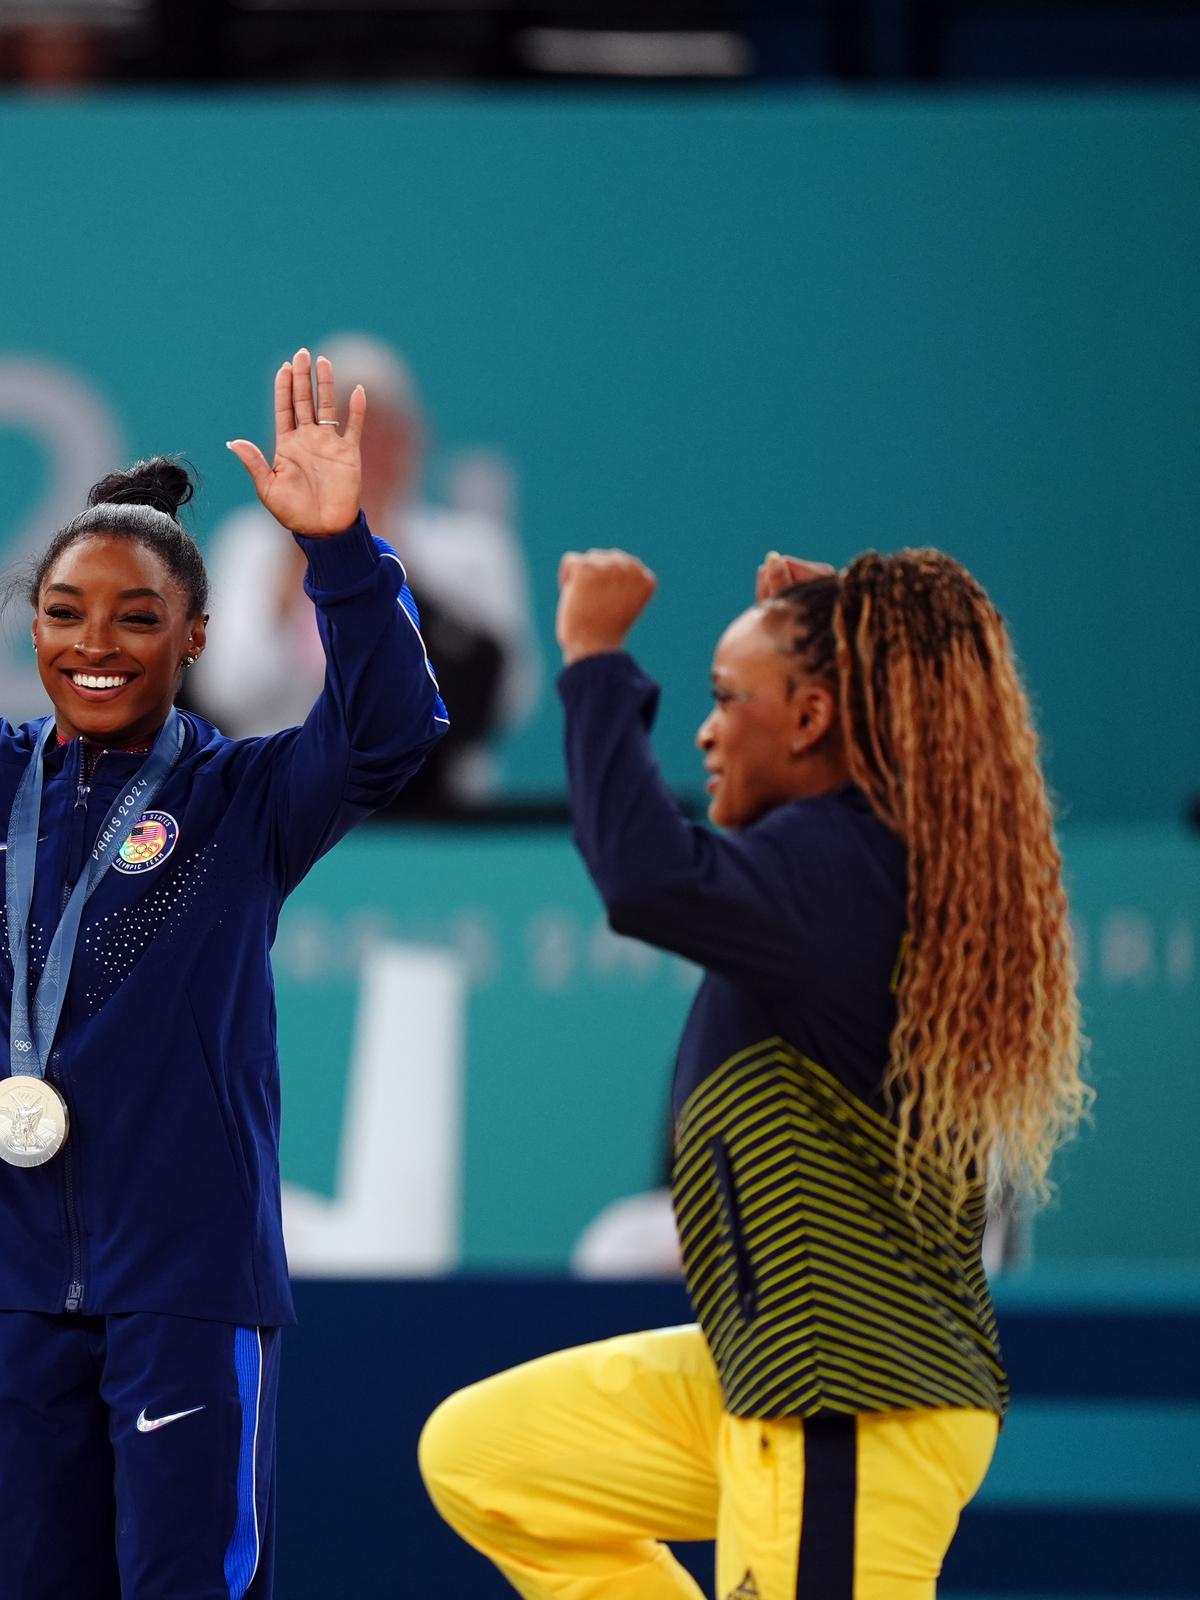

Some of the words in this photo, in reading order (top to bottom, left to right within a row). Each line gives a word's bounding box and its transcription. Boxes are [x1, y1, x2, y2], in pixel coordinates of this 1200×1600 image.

[92, 817, 121, 860] PARIS
[118, 779, 147, 816] 2024
[149, 813, 171, 827] STATES
[115, 857, 142, 870] OLYMPIC
[145, 852, 164, 867] TEAM
